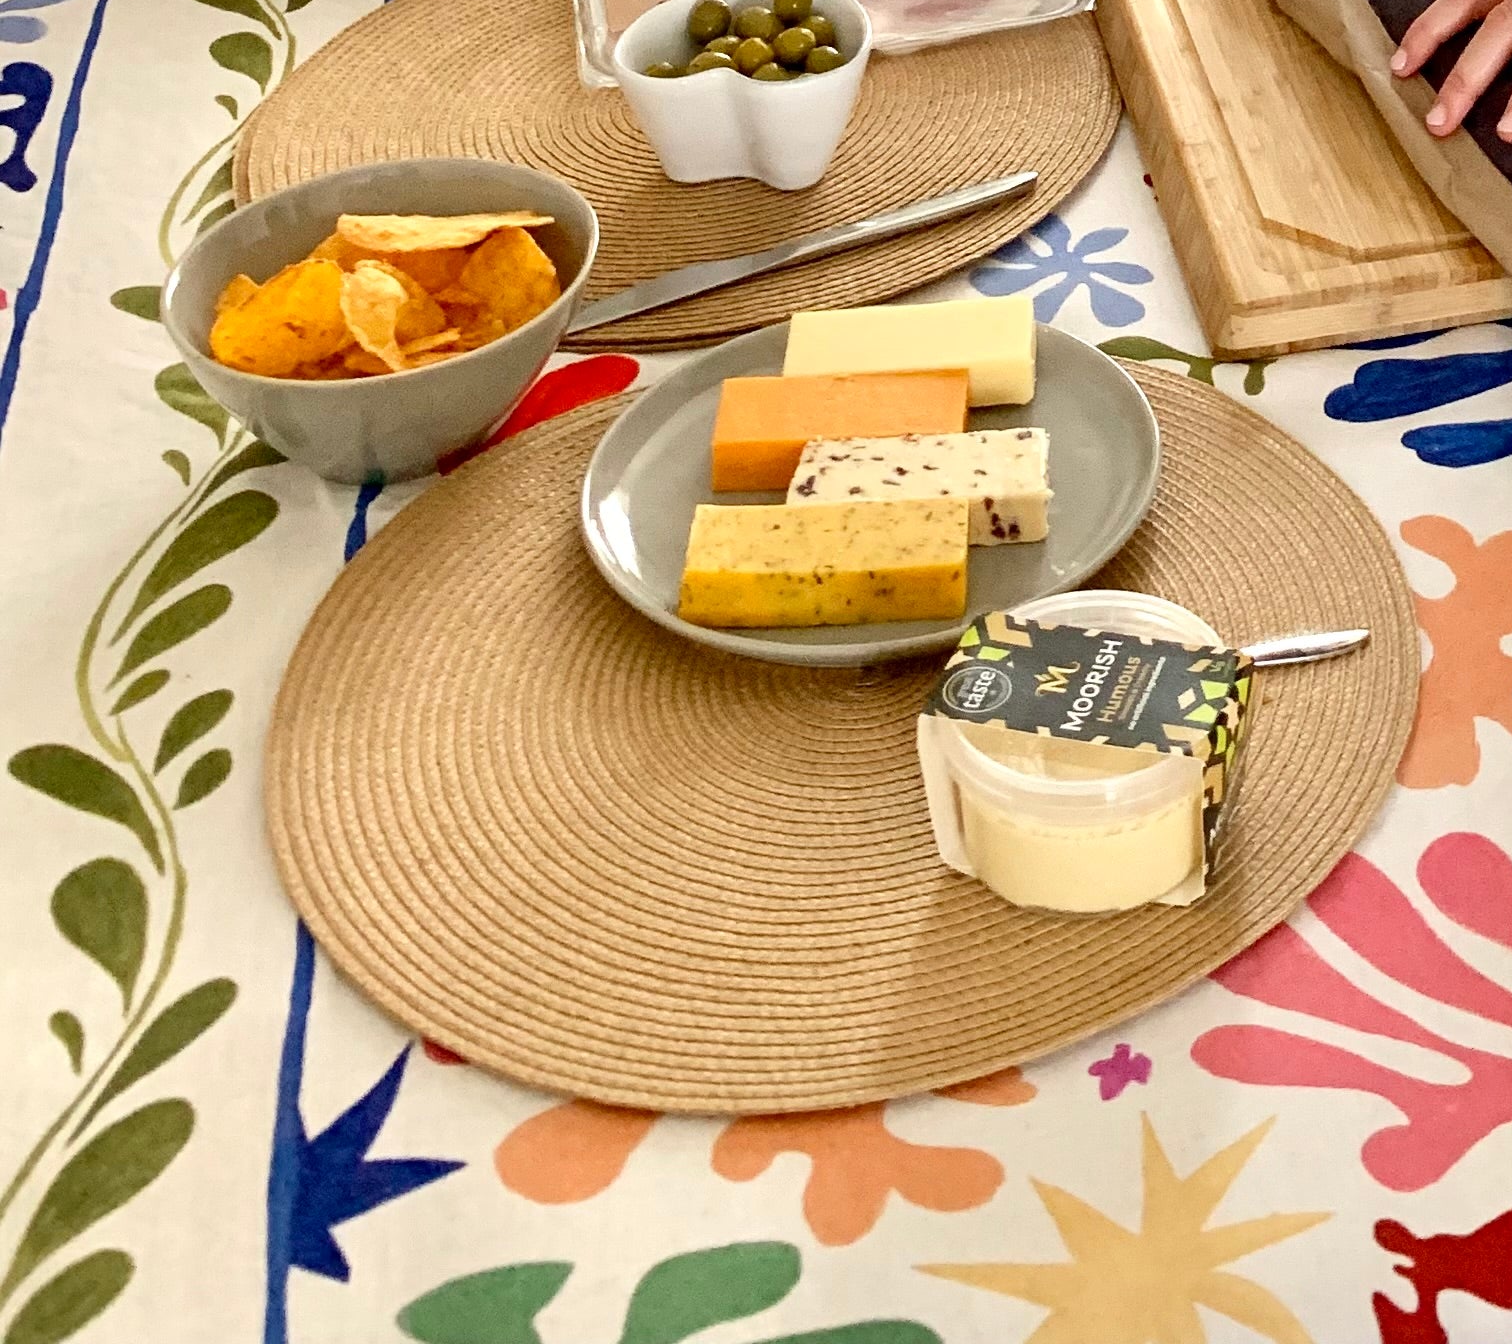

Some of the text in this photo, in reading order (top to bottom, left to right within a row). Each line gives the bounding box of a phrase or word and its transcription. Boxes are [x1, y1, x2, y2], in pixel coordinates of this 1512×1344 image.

[962, 670, 996, 709] taste
[1059, 639, 1124, 732] MOORISH
[1096, 655, 1141, 723] Humous
